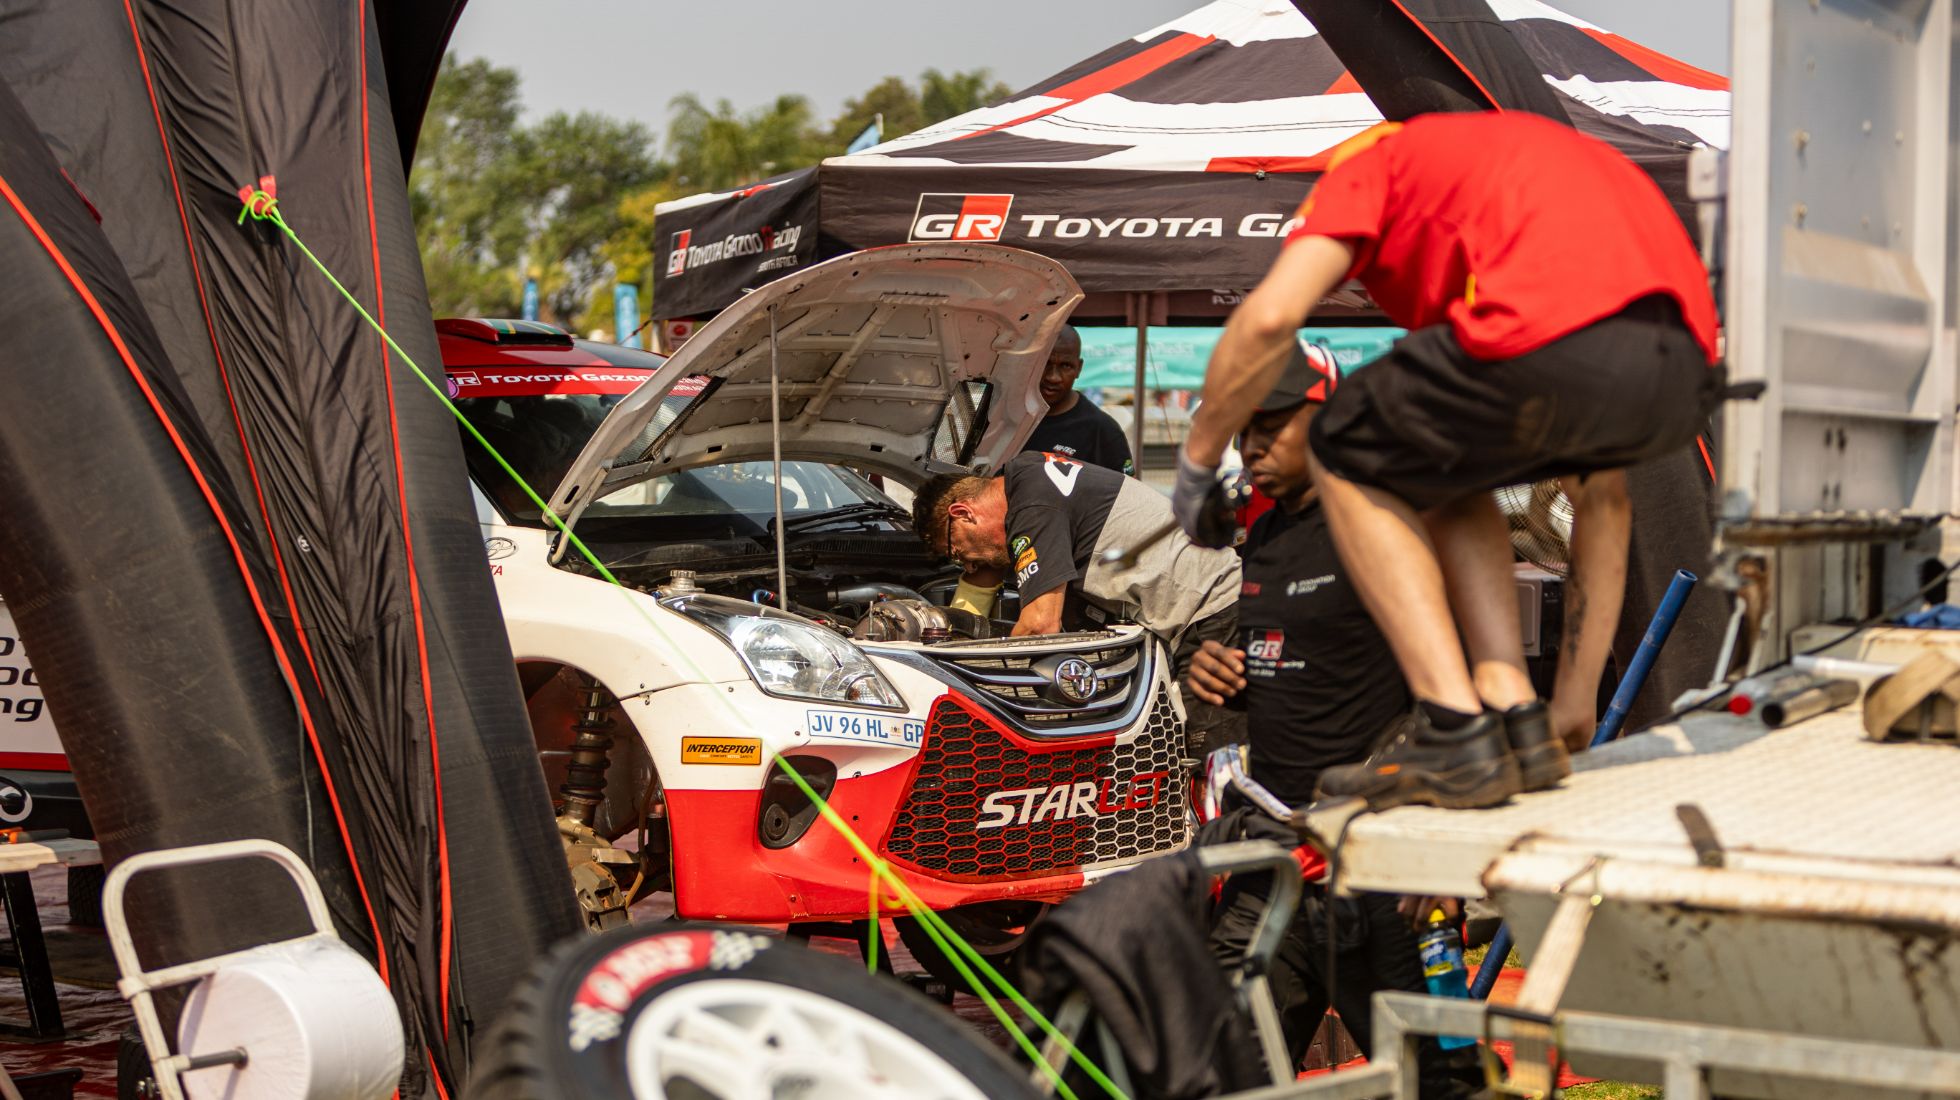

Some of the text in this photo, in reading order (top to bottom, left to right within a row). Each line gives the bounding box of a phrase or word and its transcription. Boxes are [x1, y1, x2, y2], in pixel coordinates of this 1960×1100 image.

[914, 214, 1003, 239] GR
[1020, 214, 1223, 239] TOYOTA
[686, 221, 802, 269] TOYOTA GAZOO Racing
[668, 248, 687, 272] GR
[483, 374, 580, 385] TOYOTA
[1248, 639, 1281, 658] GR
[811, 714, 925, 743] JV 96 HL GP
[686, 744, 756, 754] INTERCEPTOR
[976, 771, 1169, 829] STARLET
